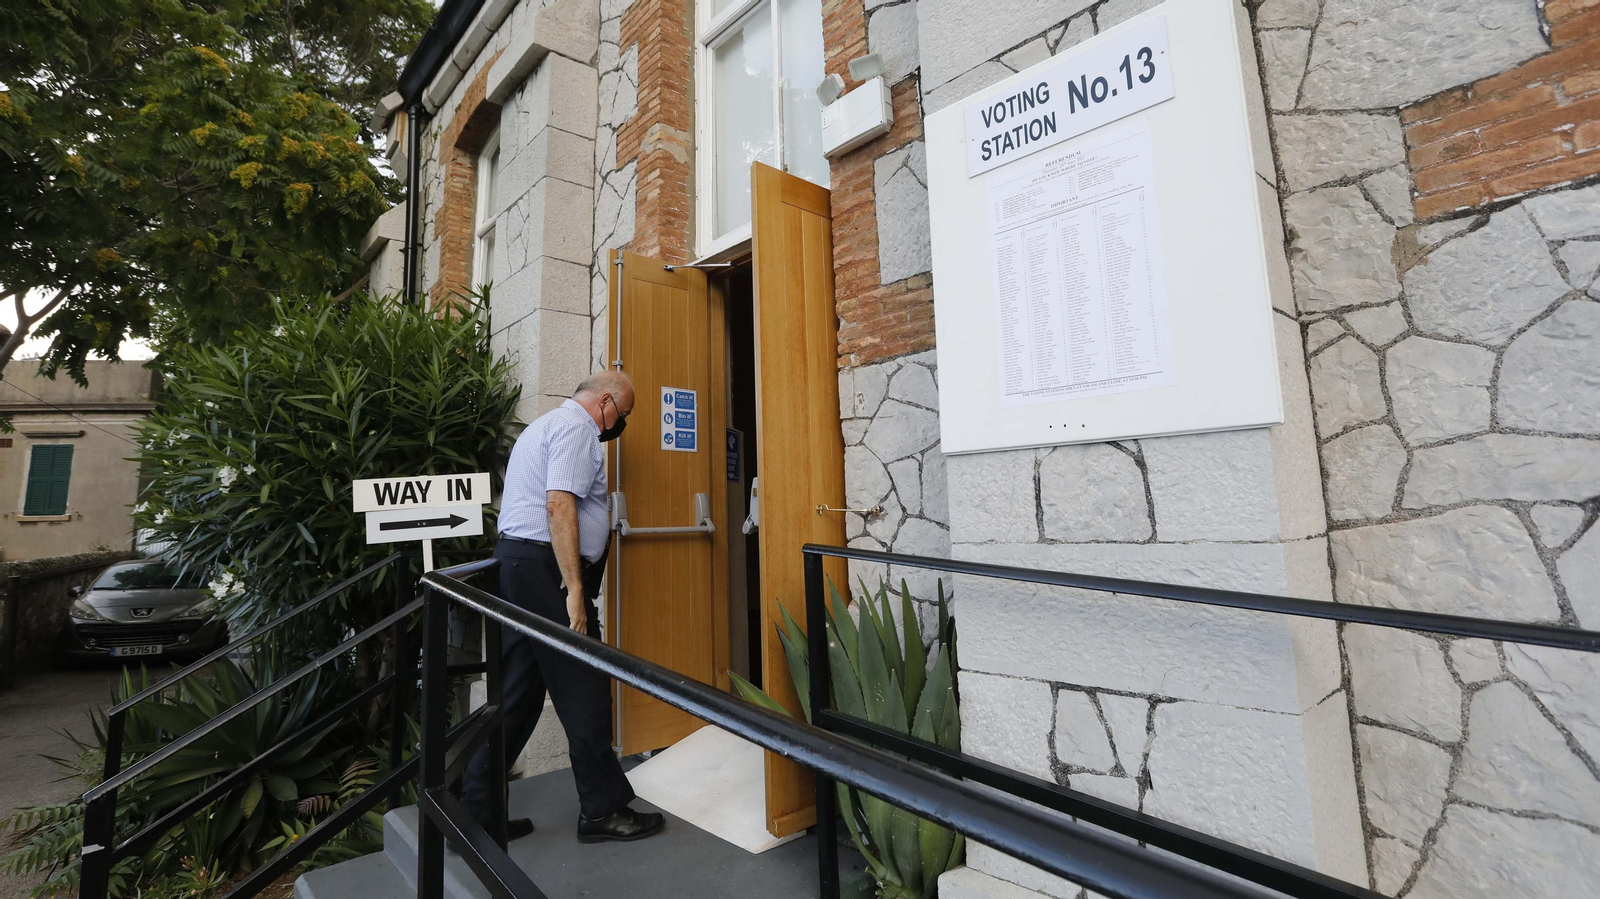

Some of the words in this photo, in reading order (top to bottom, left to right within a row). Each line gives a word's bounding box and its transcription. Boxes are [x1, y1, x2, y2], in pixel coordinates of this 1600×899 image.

[1067, 46, 1156, 114] No.13
[981, 82, 1050, 128] VOTING
[981, 111, 1057, 162] STATION
[1045, 150, 1080, 167] REFERENDUM
[1050, 195, 1078, 208] IMPORTANT
[373, 480, 432, 506] WAY
[446, 478, 472, 501] IN
